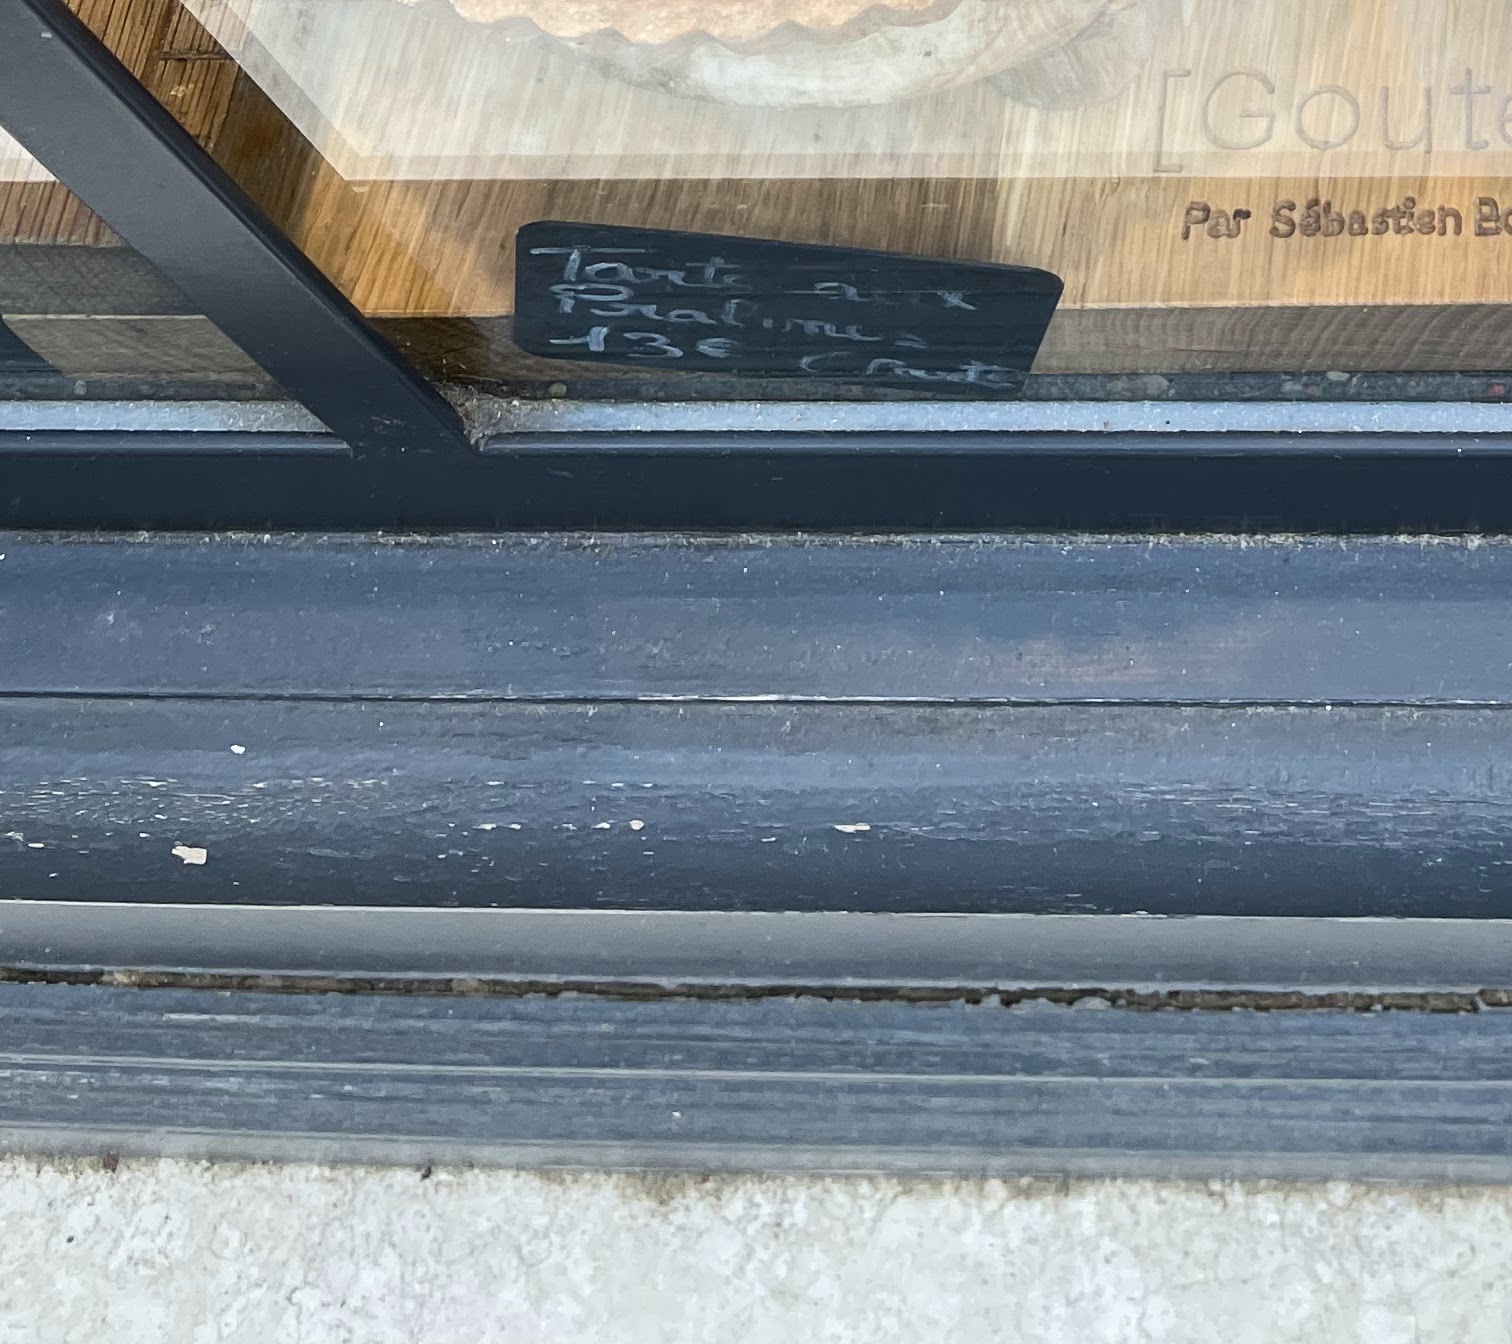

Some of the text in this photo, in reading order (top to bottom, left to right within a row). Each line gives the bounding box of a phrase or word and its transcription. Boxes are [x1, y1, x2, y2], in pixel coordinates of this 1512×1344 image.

[1181, 200, 1252, 241] Par
[1269, 196, 1463, 238] Sébastien
[530, 245, 748, 289] Tarte
